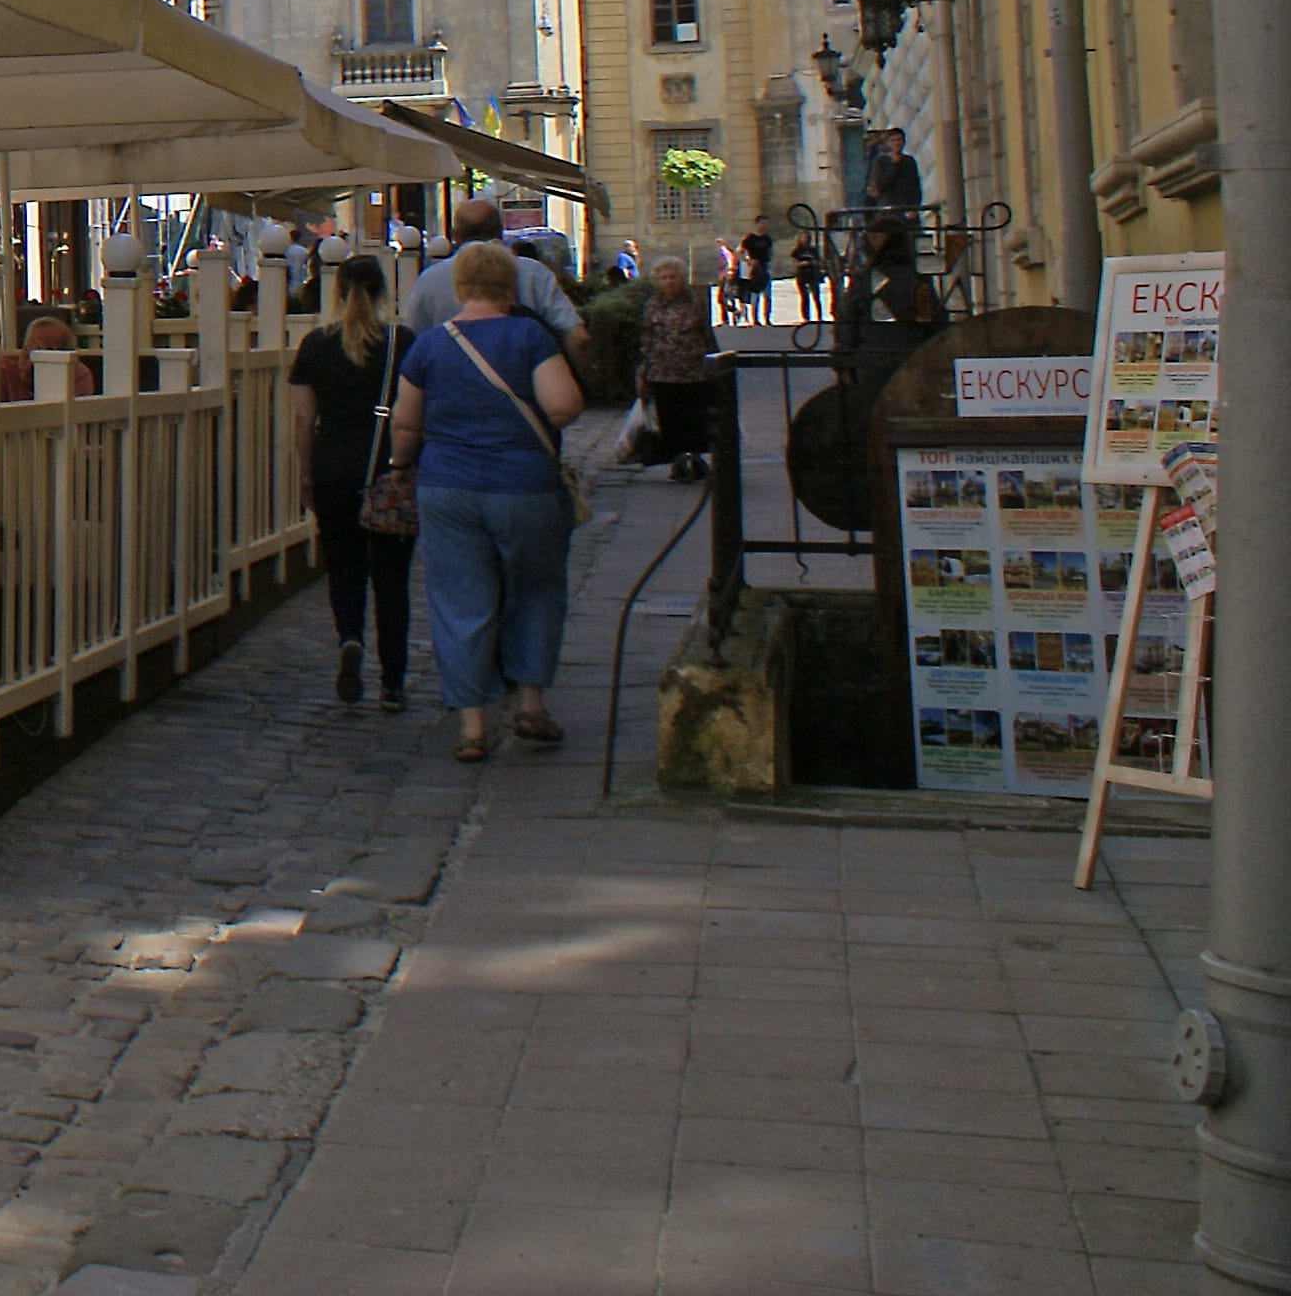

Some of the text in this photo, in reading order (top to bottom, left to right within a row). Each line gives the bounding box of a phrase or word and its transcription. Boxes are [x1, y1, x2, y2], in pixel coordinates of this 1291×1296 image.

[960, 368, 1090, 399] ЕКСКУРС
[919, 451, 950, 464] ТОП
[955, 451, 1069, 466] найцікавіших
